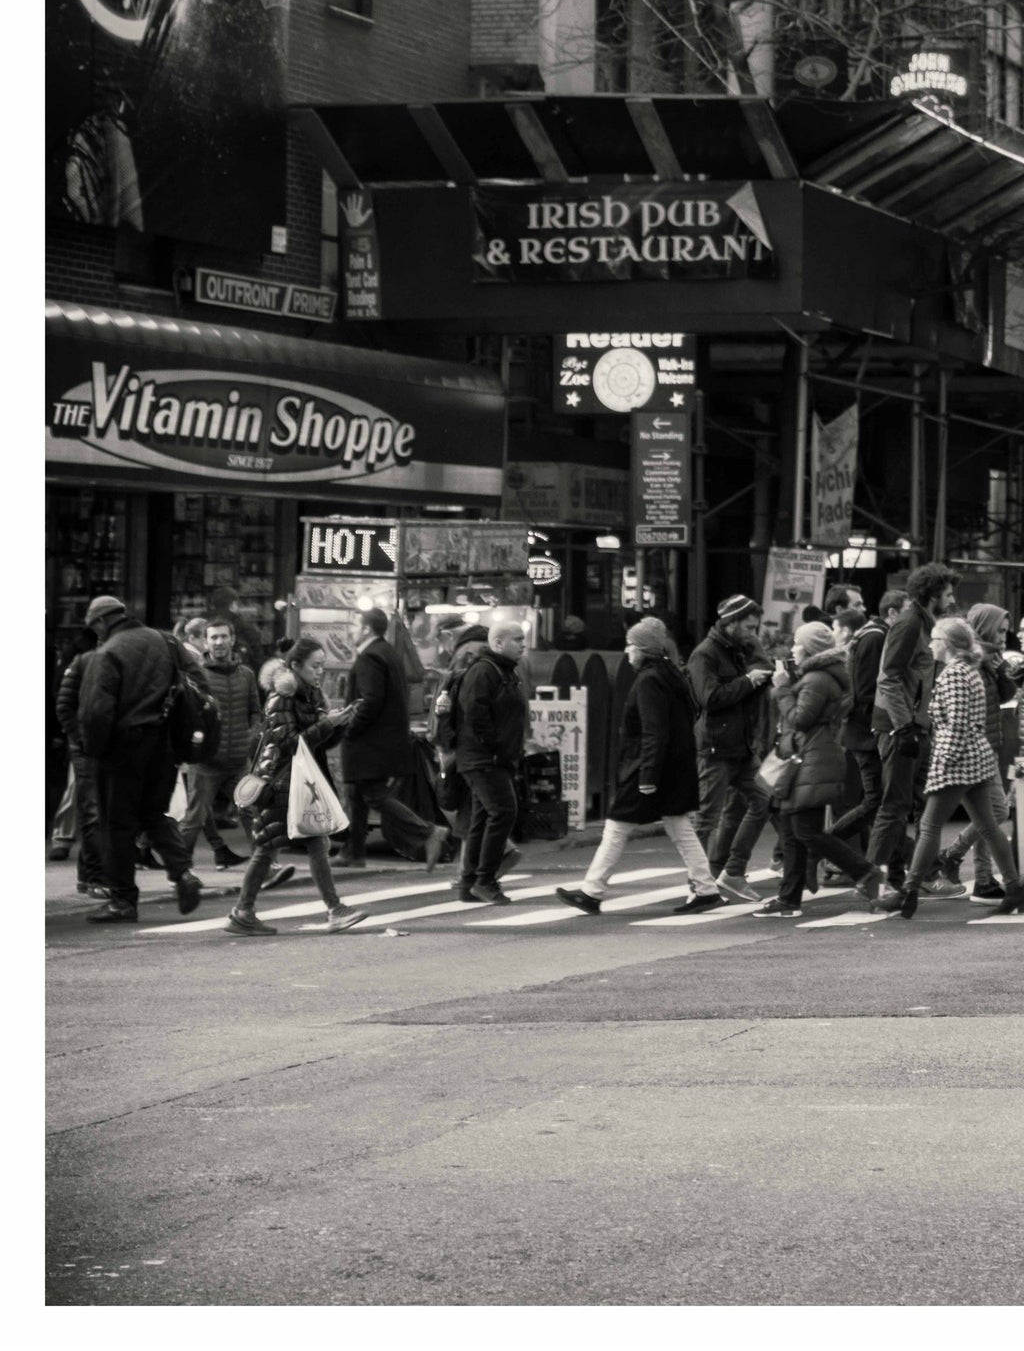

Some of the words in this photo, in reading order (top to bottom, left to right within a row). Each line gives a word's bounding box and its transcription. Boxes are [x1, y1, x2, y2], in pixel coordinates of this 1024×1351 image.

[486, 238, 511, 266] &
[518, 234, 765, 266] RESTAURANT
[206, 275, 280, 310] OUTFRONT
[293, 291, 331, 317] PRIME
[559, 370, 591, 386] Zoe
[53, 402, 91, 428] THE
[91, 361, 264, 445] Vitamin
[269, 396, 416, 466] Shoppe
[639, 431, 651, 440] No
[652, 431, 685, 442] Standing
[309, 527, 377, 566] HOT
[547, 710, 578, 723] WORK
